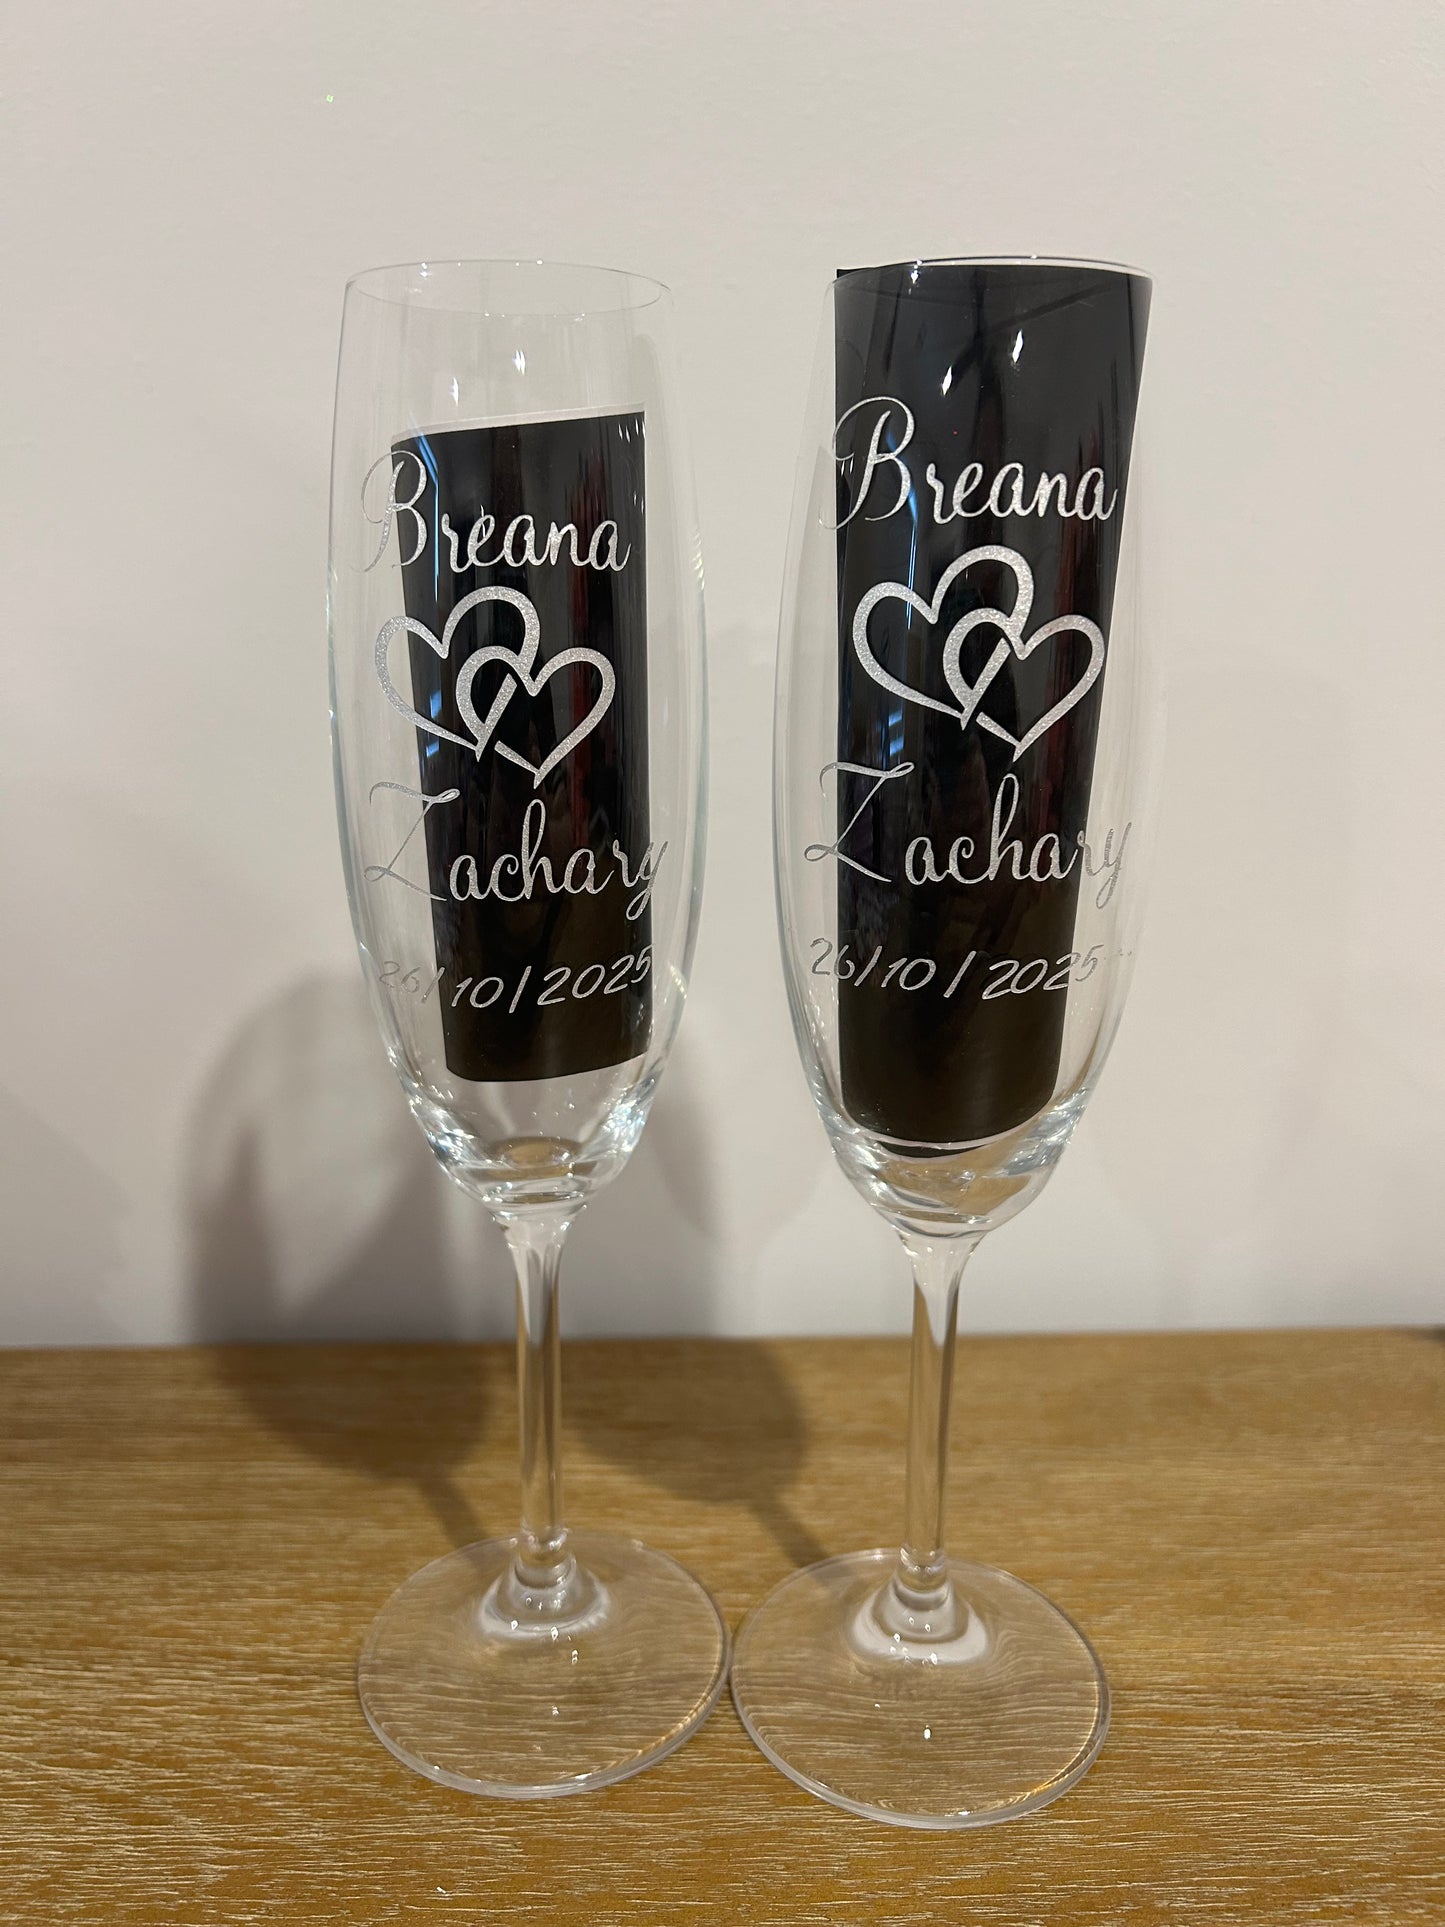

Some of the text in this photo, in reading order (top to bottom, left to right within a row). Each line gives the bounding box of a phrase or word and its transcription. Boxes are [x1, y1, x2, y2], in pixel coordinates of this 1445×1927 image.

[354, 450, 632, 573] Breana
[820, 396, 1118, 531] Breana
[364, 781, 668, 921] Zachary
[804, 762, 1132, 909] Zachary
[810, 938, 1104, 1000] 26/10/2025
